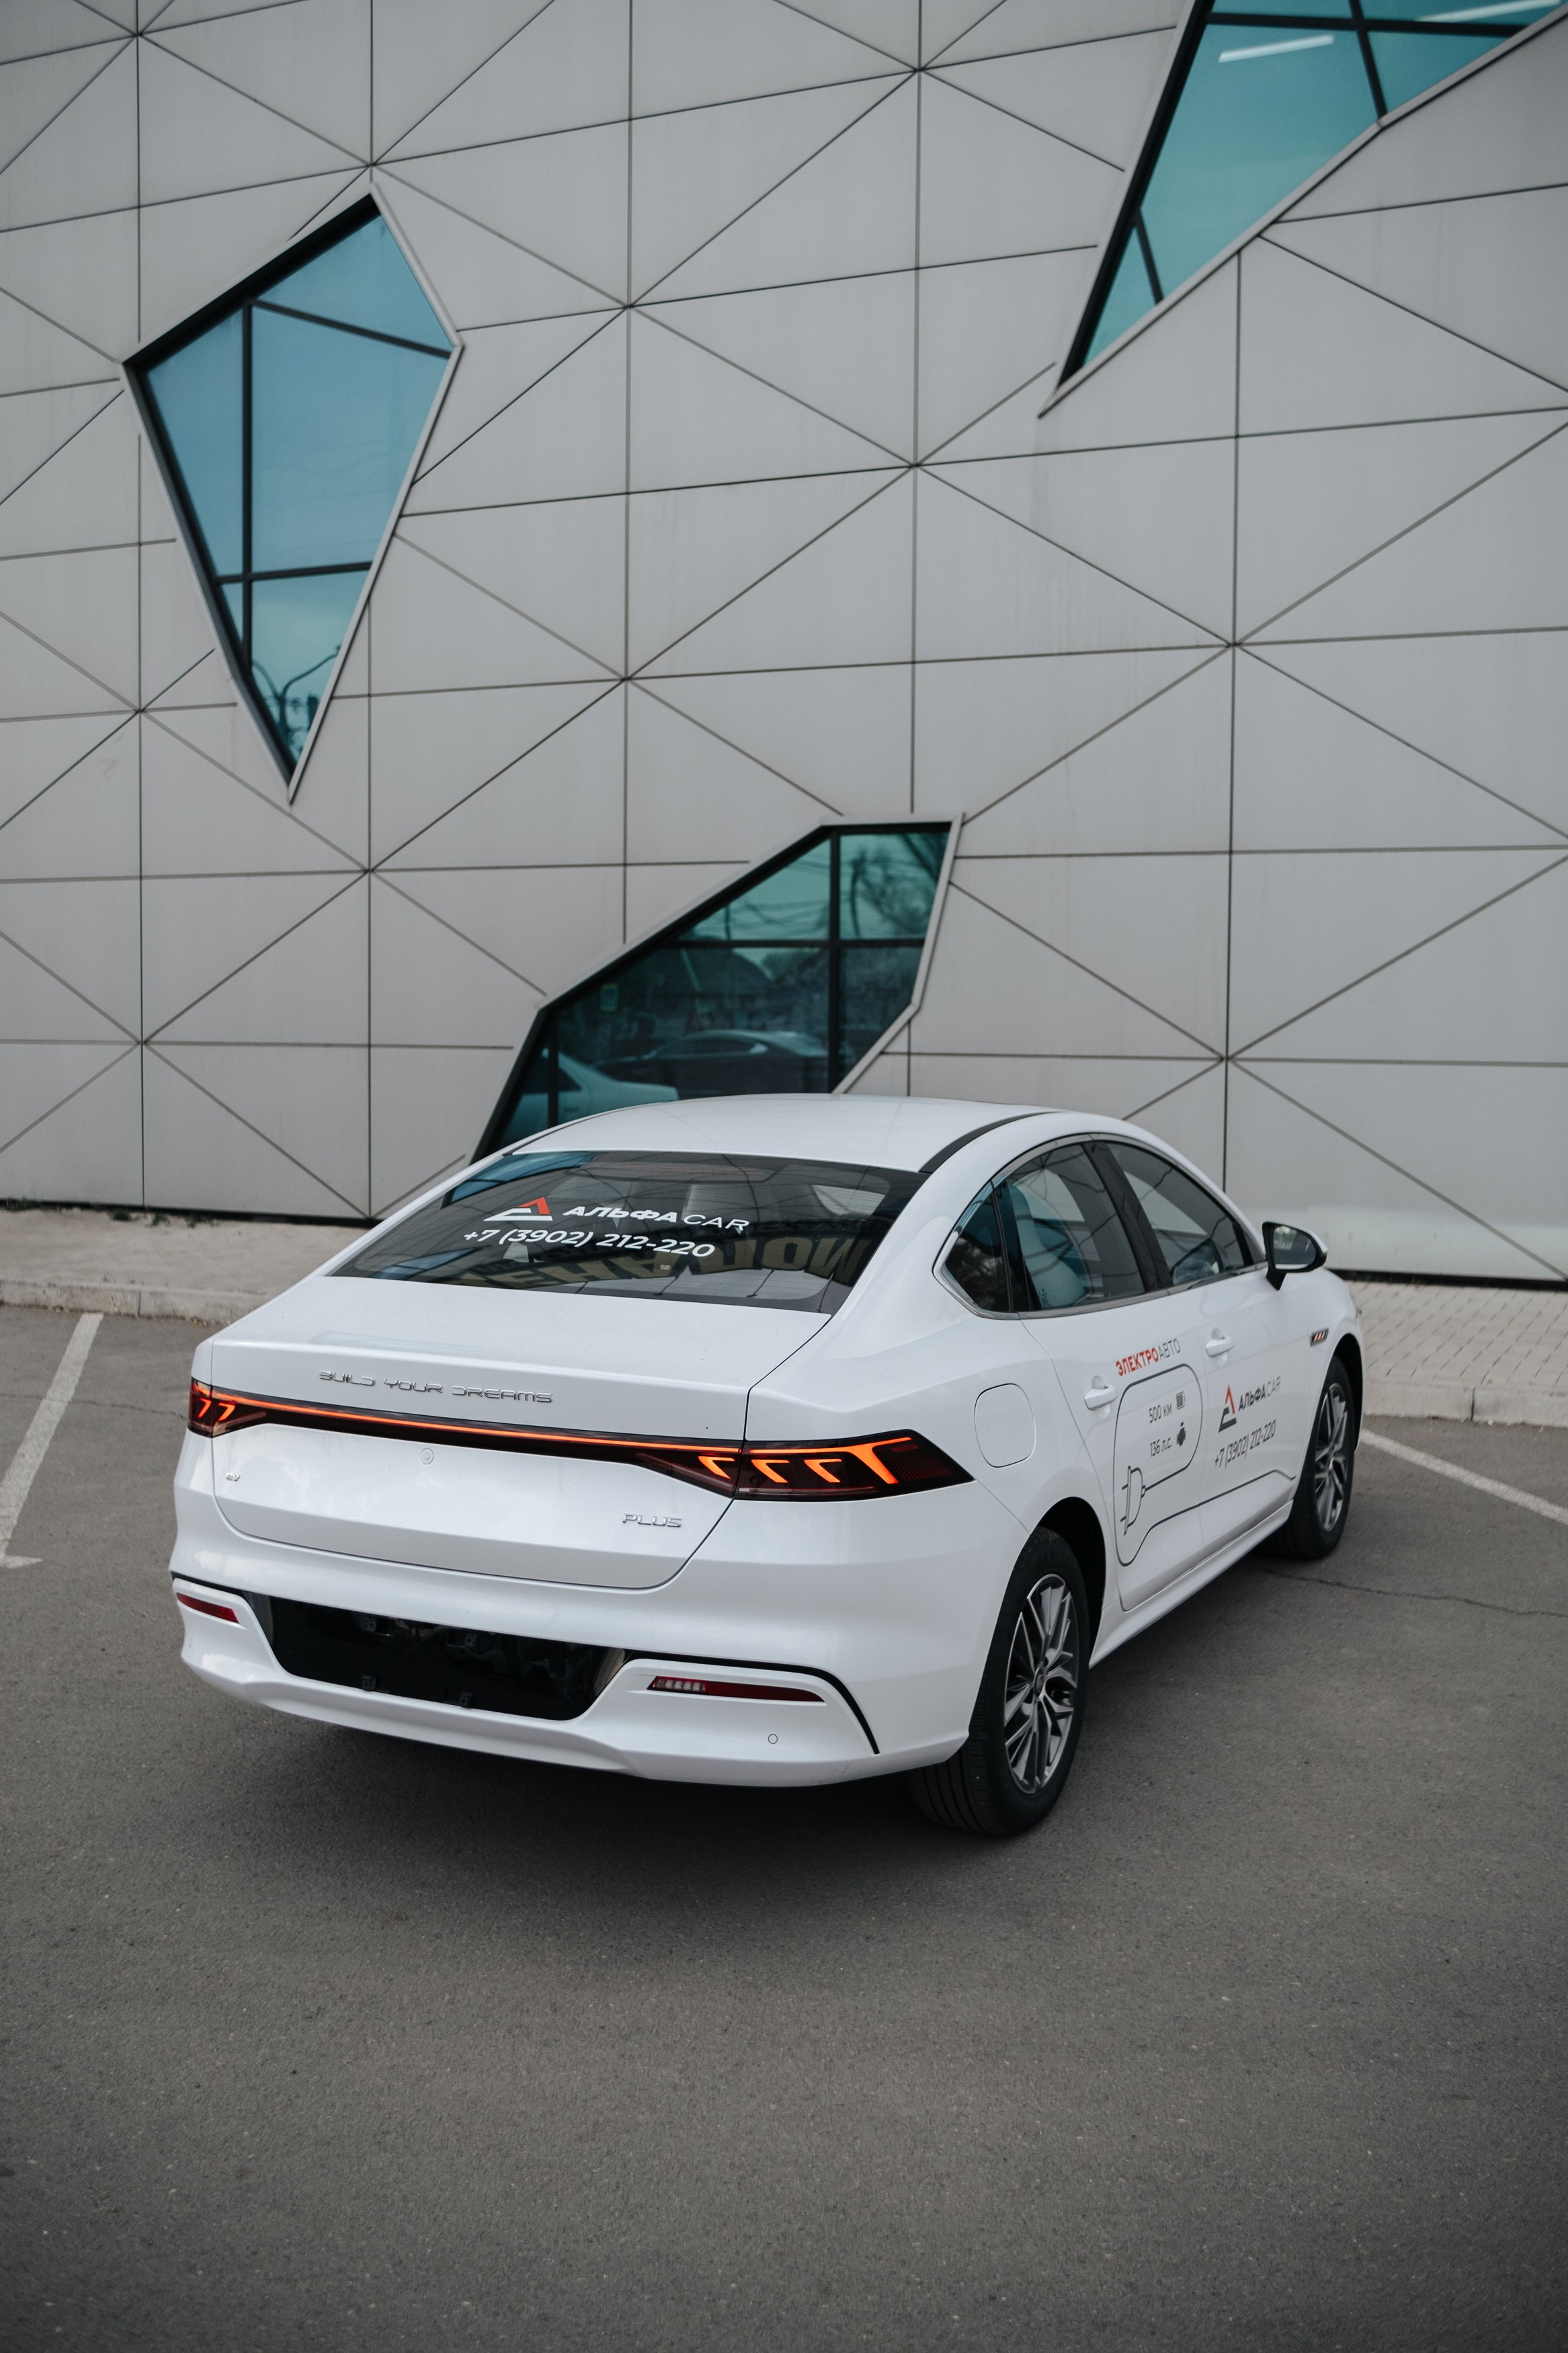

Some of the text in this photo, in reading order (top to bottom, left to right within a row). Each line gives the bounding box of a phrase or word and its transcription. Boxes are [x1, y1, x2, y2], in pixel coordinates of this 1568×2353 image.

[562, 1206, 749, 1231] АЛЬФА CAR
[464, 1229, 715, 1257] +7 (3902) 212-220
[1116, 1339, 1181, 1376] ЭЛЕКТРОАВТО
[319, 1370, 553, 1403] BUILD YOUR DREAMS
[1149, 1404, 1161, 1423] 500
[1150, 1439, 1161, 1458] 136
[1214, 1419, 1276, 1469] +7 (3902) 212-220
[622, 1513, 682, 1527] PLUS
